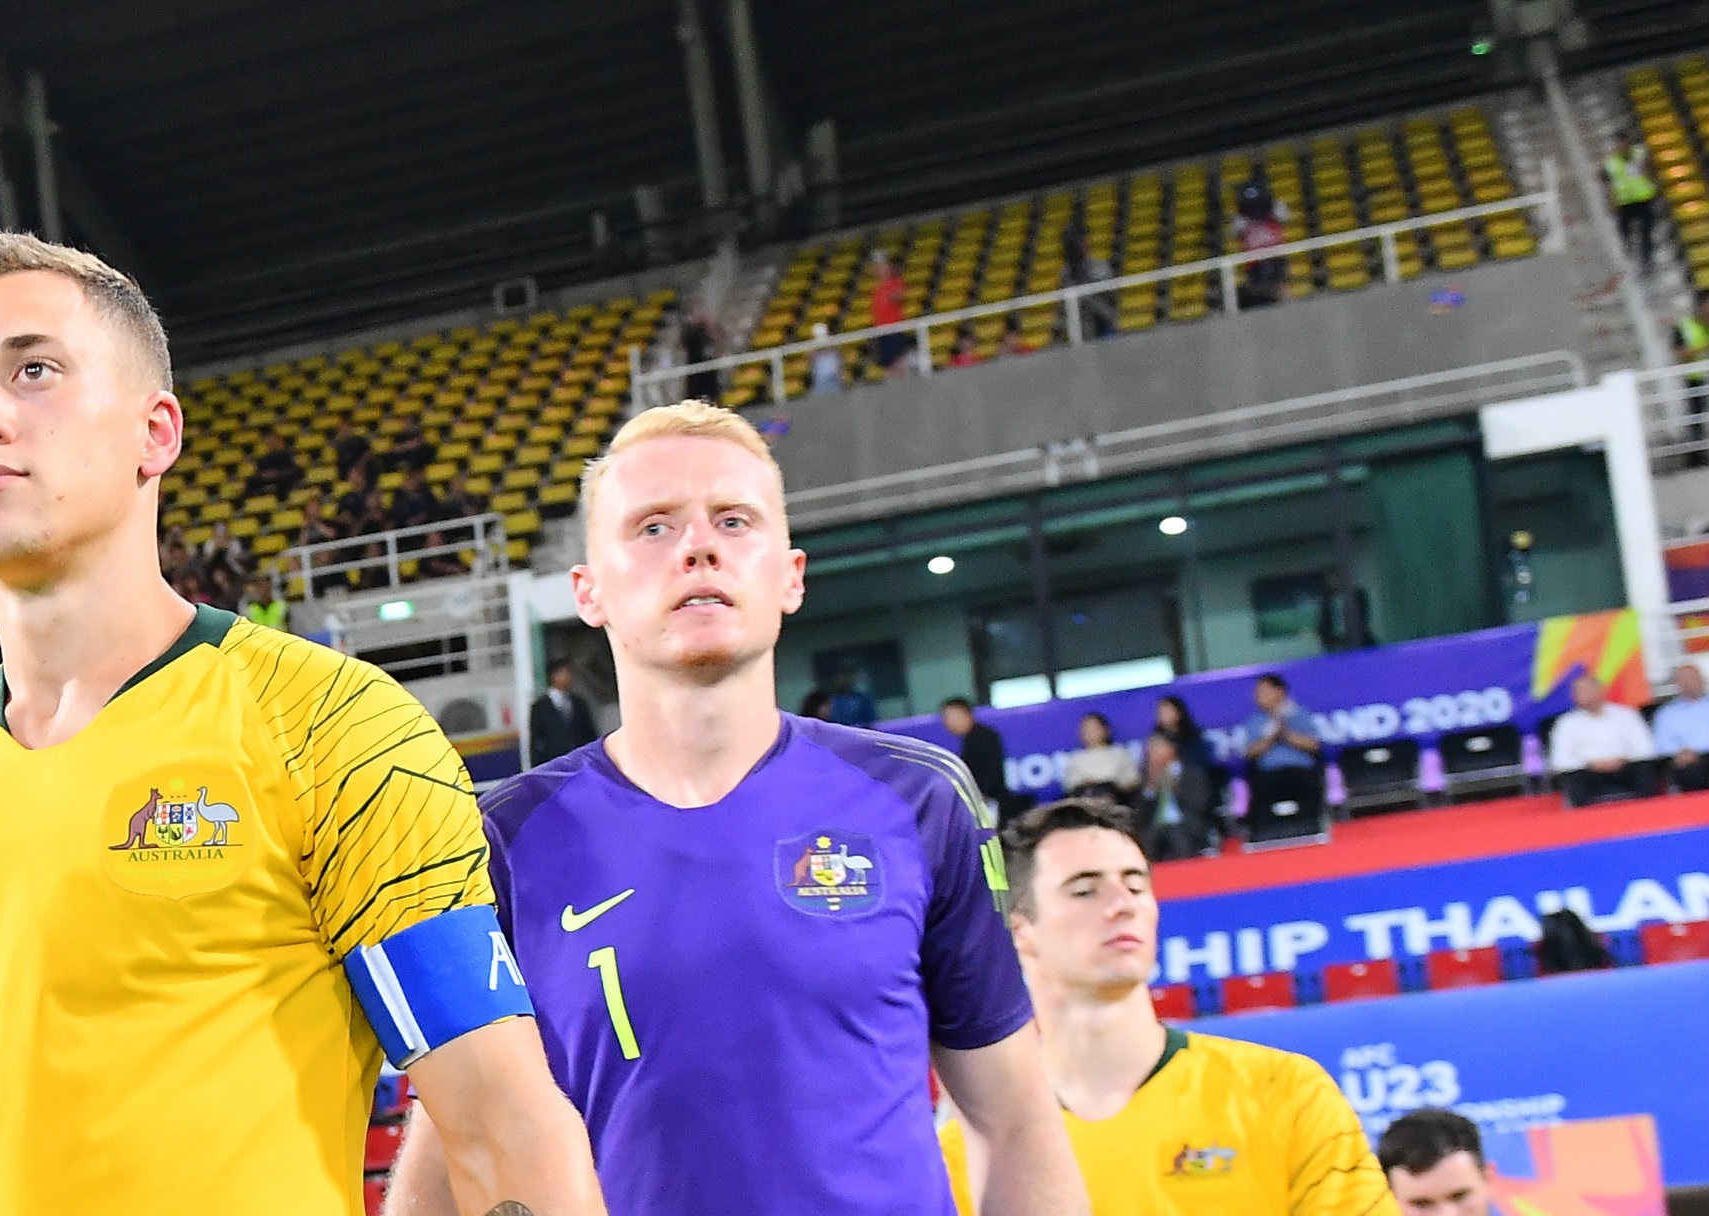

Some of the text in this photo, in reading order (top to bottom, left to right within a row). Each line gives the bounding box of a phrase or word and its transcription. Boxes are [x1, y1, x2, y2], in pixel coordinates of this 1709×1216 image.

[1404, 686, 1514, 735] 2020
[128, 848, 224, 862] AUSTRALIA
[587, 946, 641, 1061] 1
[1341, 1059, 1461, 1114] U23
